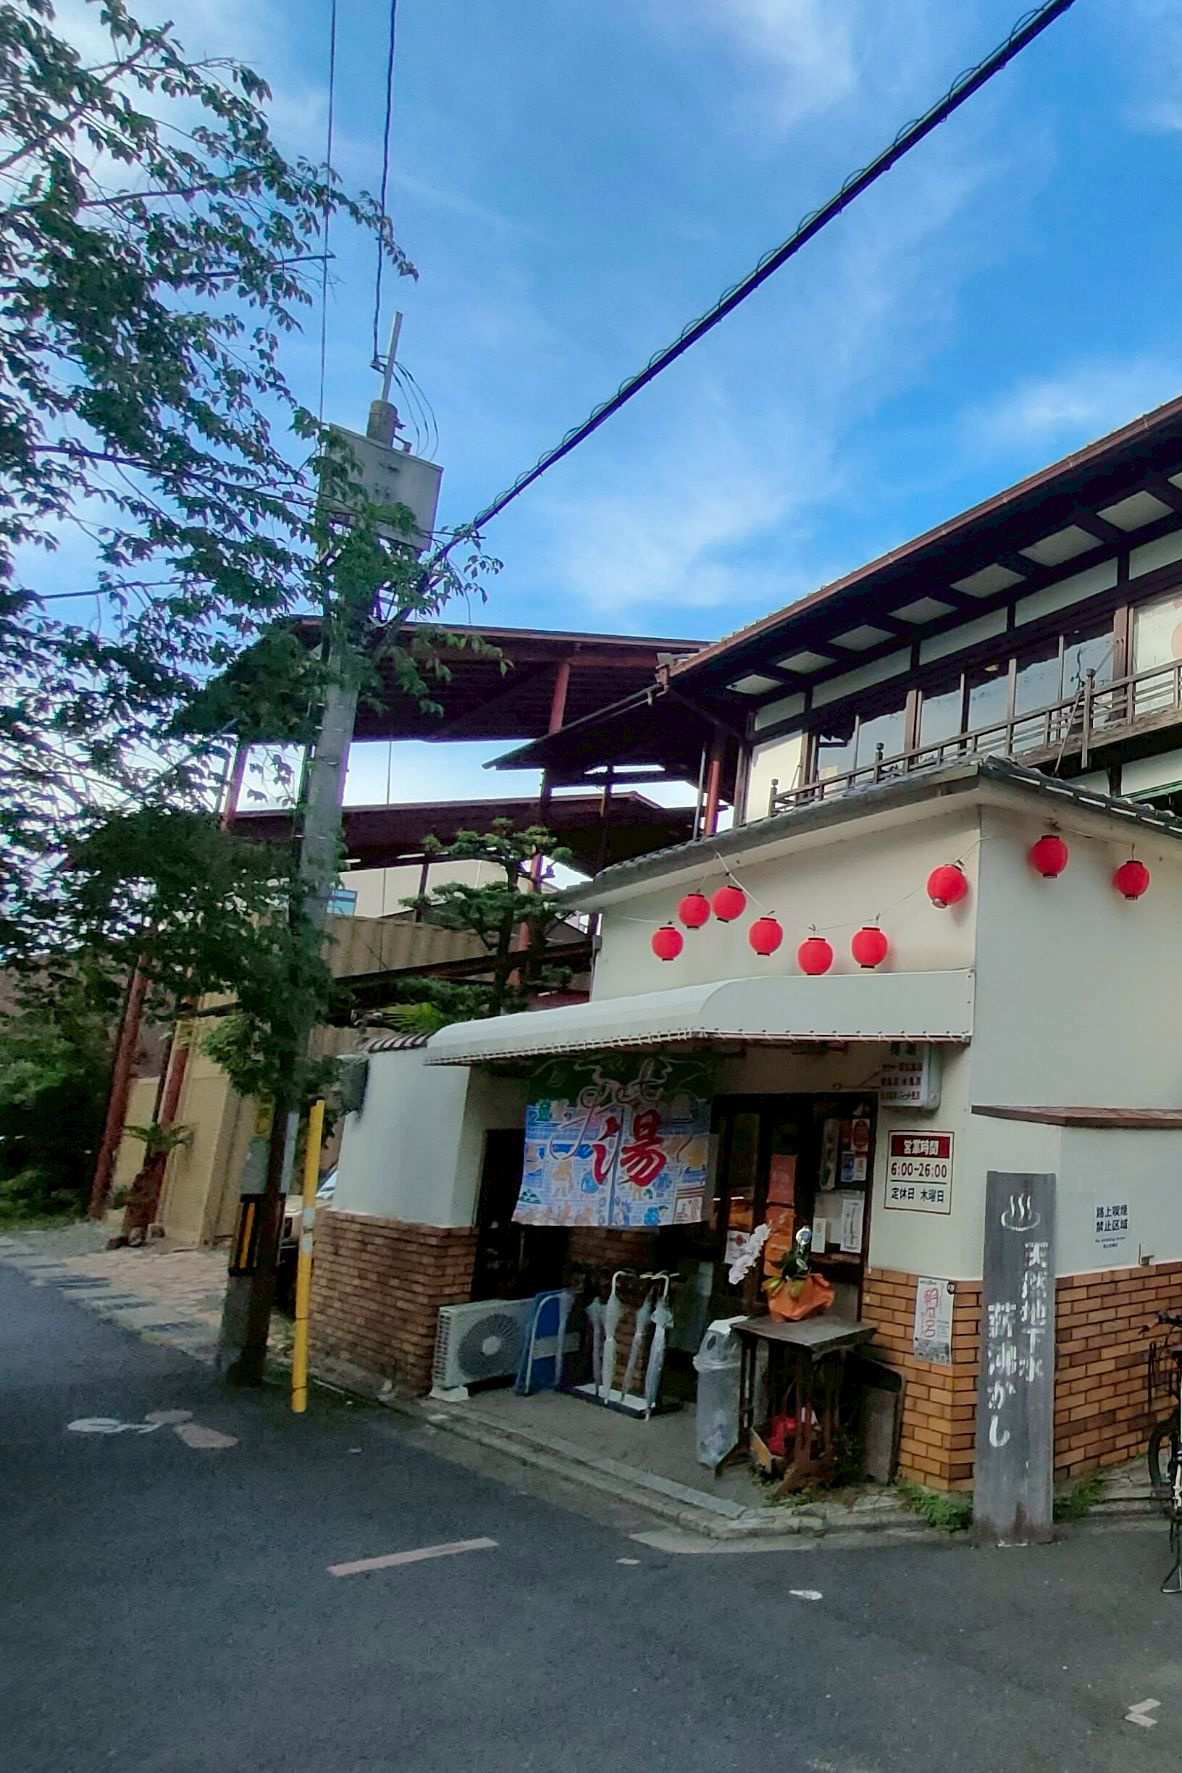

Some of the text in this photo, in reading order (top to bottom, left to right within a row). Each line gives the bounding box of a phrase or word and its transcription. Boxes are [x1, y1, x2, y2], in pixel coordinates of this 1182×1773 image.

[903, 1139, 940, 1156] 営業時間
[891, 1187, 944, 1203] 定休日 木曜日
[1096, 1204, 1128, 1219] 路上喫煙
[1096, 1218, 1128, 1233] 禁止区域
[1019, 1242, 1049, 1383] 天然地下水
